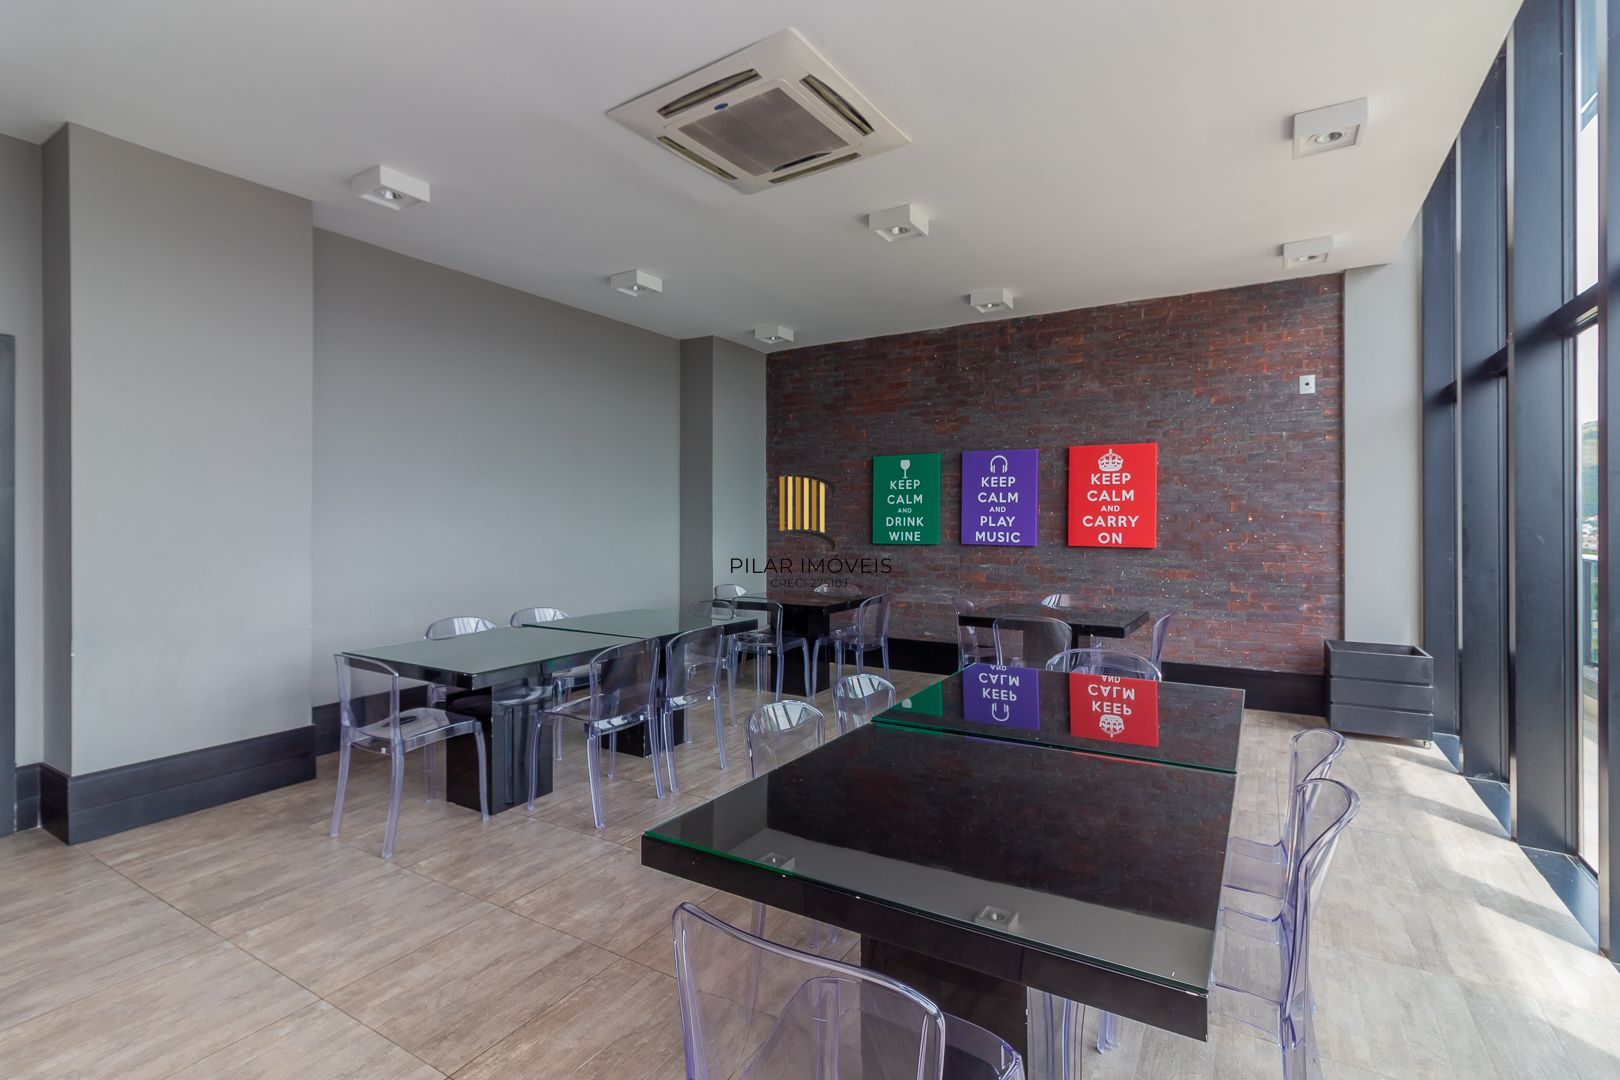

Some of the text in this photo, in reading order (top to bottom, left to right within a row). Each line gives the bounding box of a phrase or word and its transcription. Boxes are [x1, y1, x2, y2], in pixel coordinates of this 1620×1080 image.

[981, 476, 1016, 487] KEEP
[1090, 472, 1131, 485] KEEP
[890, 479, 920, 490] KEEP
[887, 494, 923, 505] CALM
[977, 492, 1019, 503] CALM
[1086, 489, 1135, 502] CALM
[885, 516, 924, 527] DRINK
[980, 516, 1015, 527] PLAY
[1082, 515, 1139, 528] CARRY
[888, 531, 921, 542] WINE
[975, 531, 1021, 543] MUSIC
[1097, 532, 1122, 545] ON
